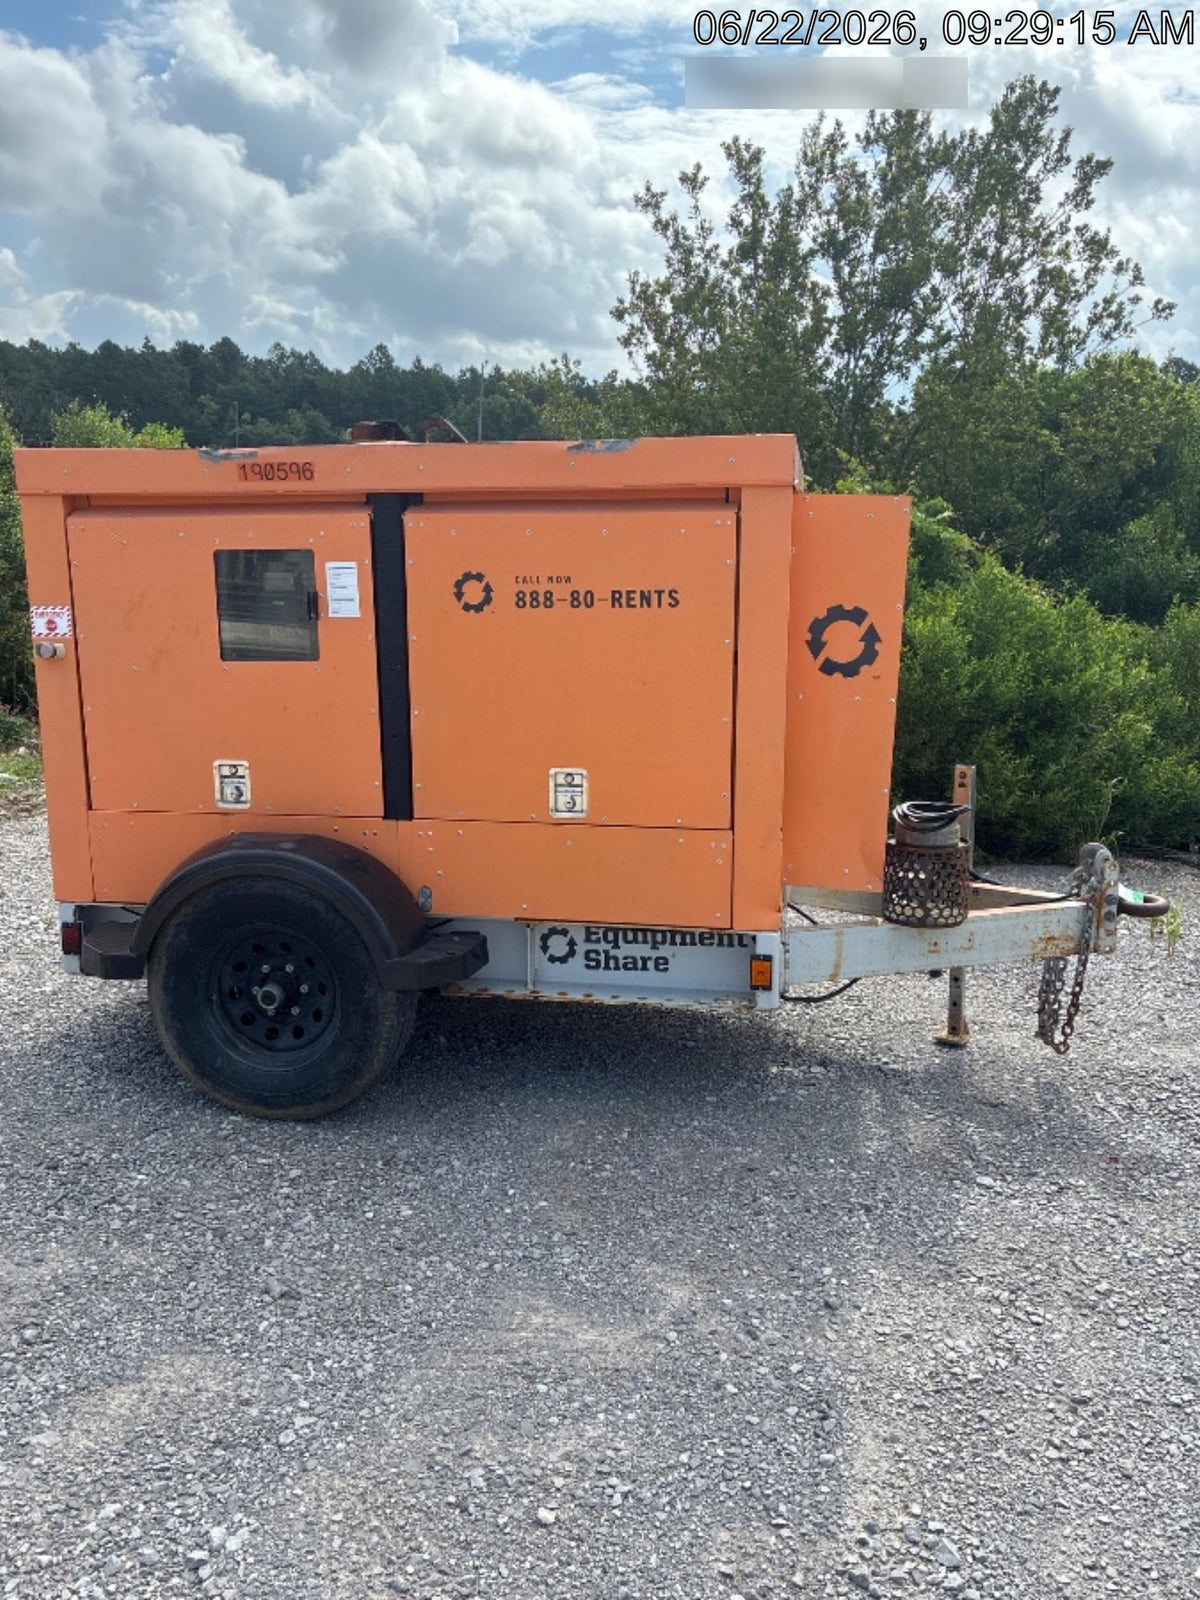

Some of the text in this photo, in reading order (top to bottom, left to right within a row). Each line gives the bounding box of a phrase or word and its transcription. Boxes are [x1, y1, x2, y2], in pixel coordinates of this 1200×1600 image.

[239, 461, 314, 481] 190596
[514, 575, 572, 585] CALL NOW
[514, 589, 680, 609] 888-80-RENTS
[583, 927, 749, 949] Equipment
[584, 949, 669, 972] Share
